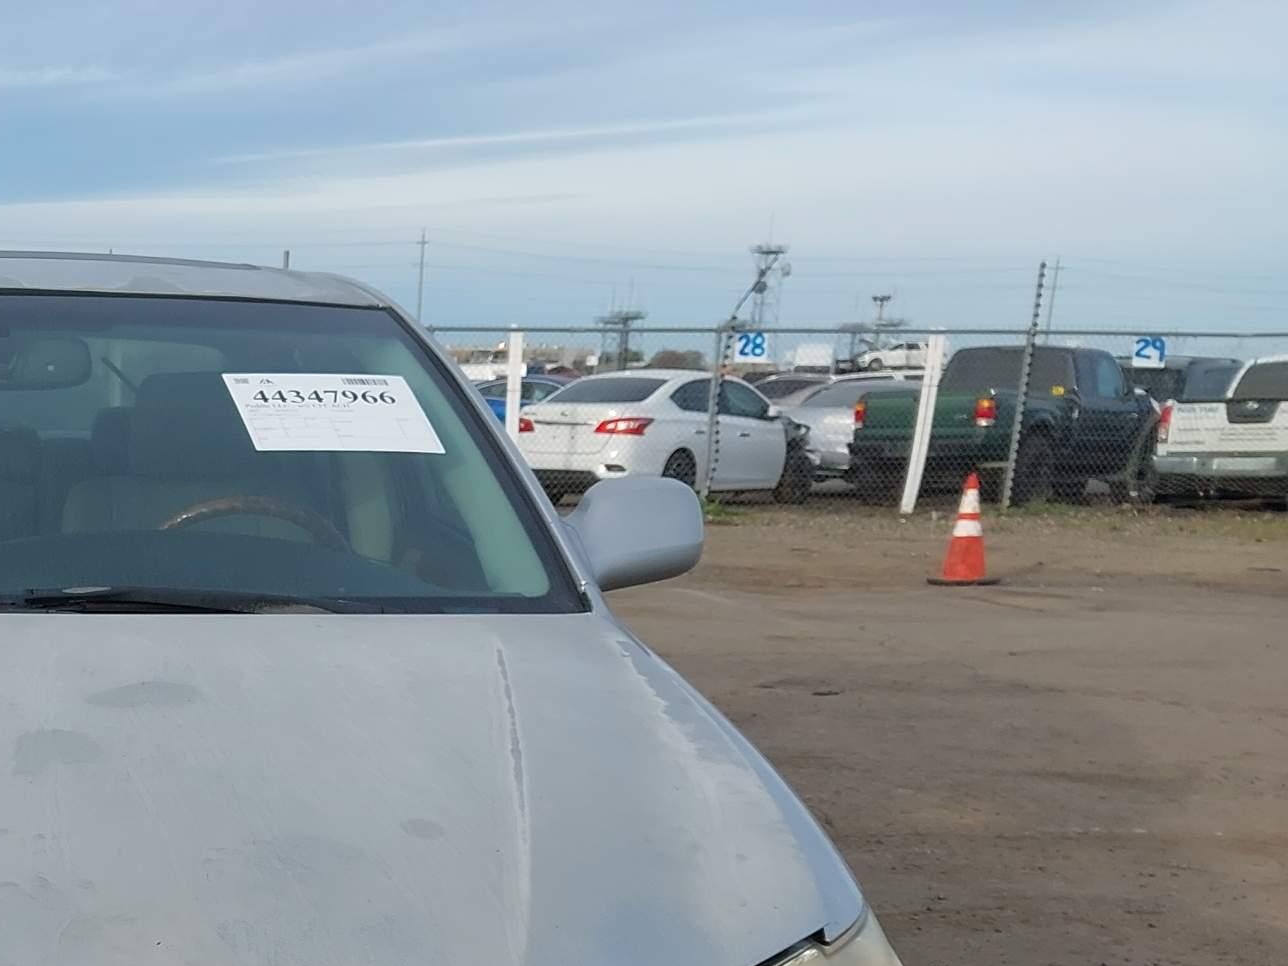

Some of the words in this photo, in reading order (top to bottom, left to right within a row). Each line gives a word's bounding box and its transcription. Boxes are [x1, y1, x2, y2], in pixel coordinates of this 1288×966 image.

[738, 330, 765, 357] 28
[1135, 336, 1166, 362] 29
[253, 389, 396, 405] 44347966
